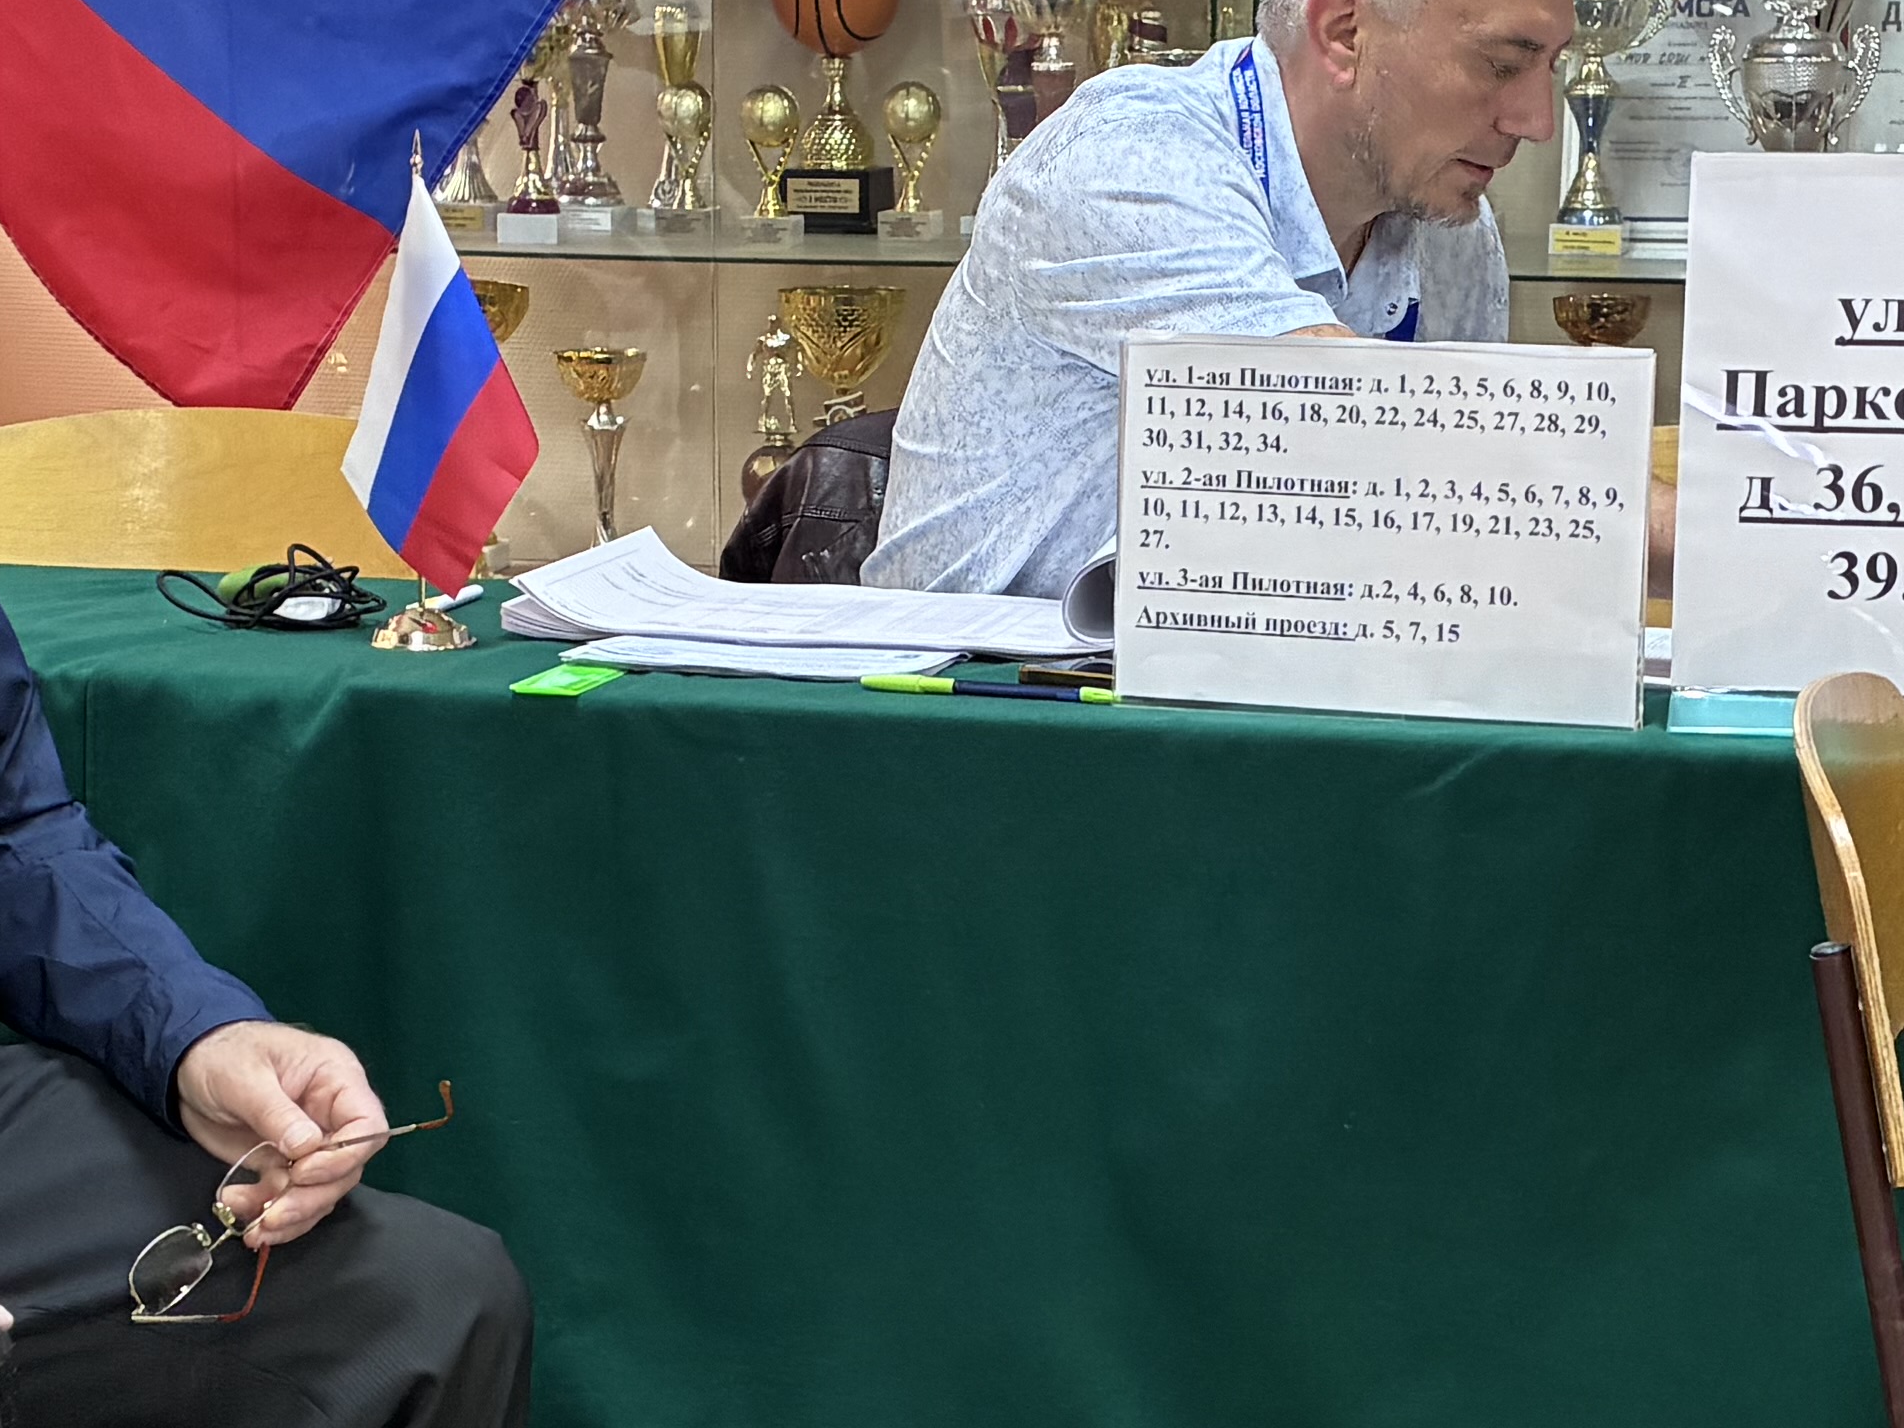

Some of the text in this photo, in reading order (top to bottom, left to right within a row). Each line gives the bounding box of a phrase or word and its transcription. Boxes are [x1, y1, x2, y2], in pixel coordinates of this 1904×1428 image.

[1145, 365, 1617, 407] ул. 1-ая Пилотная: д. 1, 2, 3, 5, 6, 8, 9, 10,
[1146, 395, 1607, 440] 11, 12, 14, 16, 18, 20, 22, 24, 25, 27, 28, 29,
[1141, 427, 1288, 456] 30, 31, 32, 34.
[1141, 466, 1625, 513] ул. 2-ая Пилотная: д. 1, 2, 3, 4, 5, 6, 7, 8, 9,
[1739, 476, 1788, 518] д.
[1813, 463, 1901, 522] 36,
[1139, 528, 1171, 550] 27.
[1143, 497, 1601, 544] 10, 11, 12, 13, 14, 15, 16, 17, 19, 21, 23, 25,
[1138, 571, 1170, 588] ул.
[1176, 567, 1224, 589] 3-ая
[1231, 571, 1354, 598] Пилотная:
[1406, 581, 1427, 606] 4,
[1433, 582, 1453, 607] 6,
[1459, 583, 1479, 609] 8,
[1487, 585, 1519, 607] 10.
[1136, 605, 1461, 645] Архивный проезд: д. 5, 7, 15
